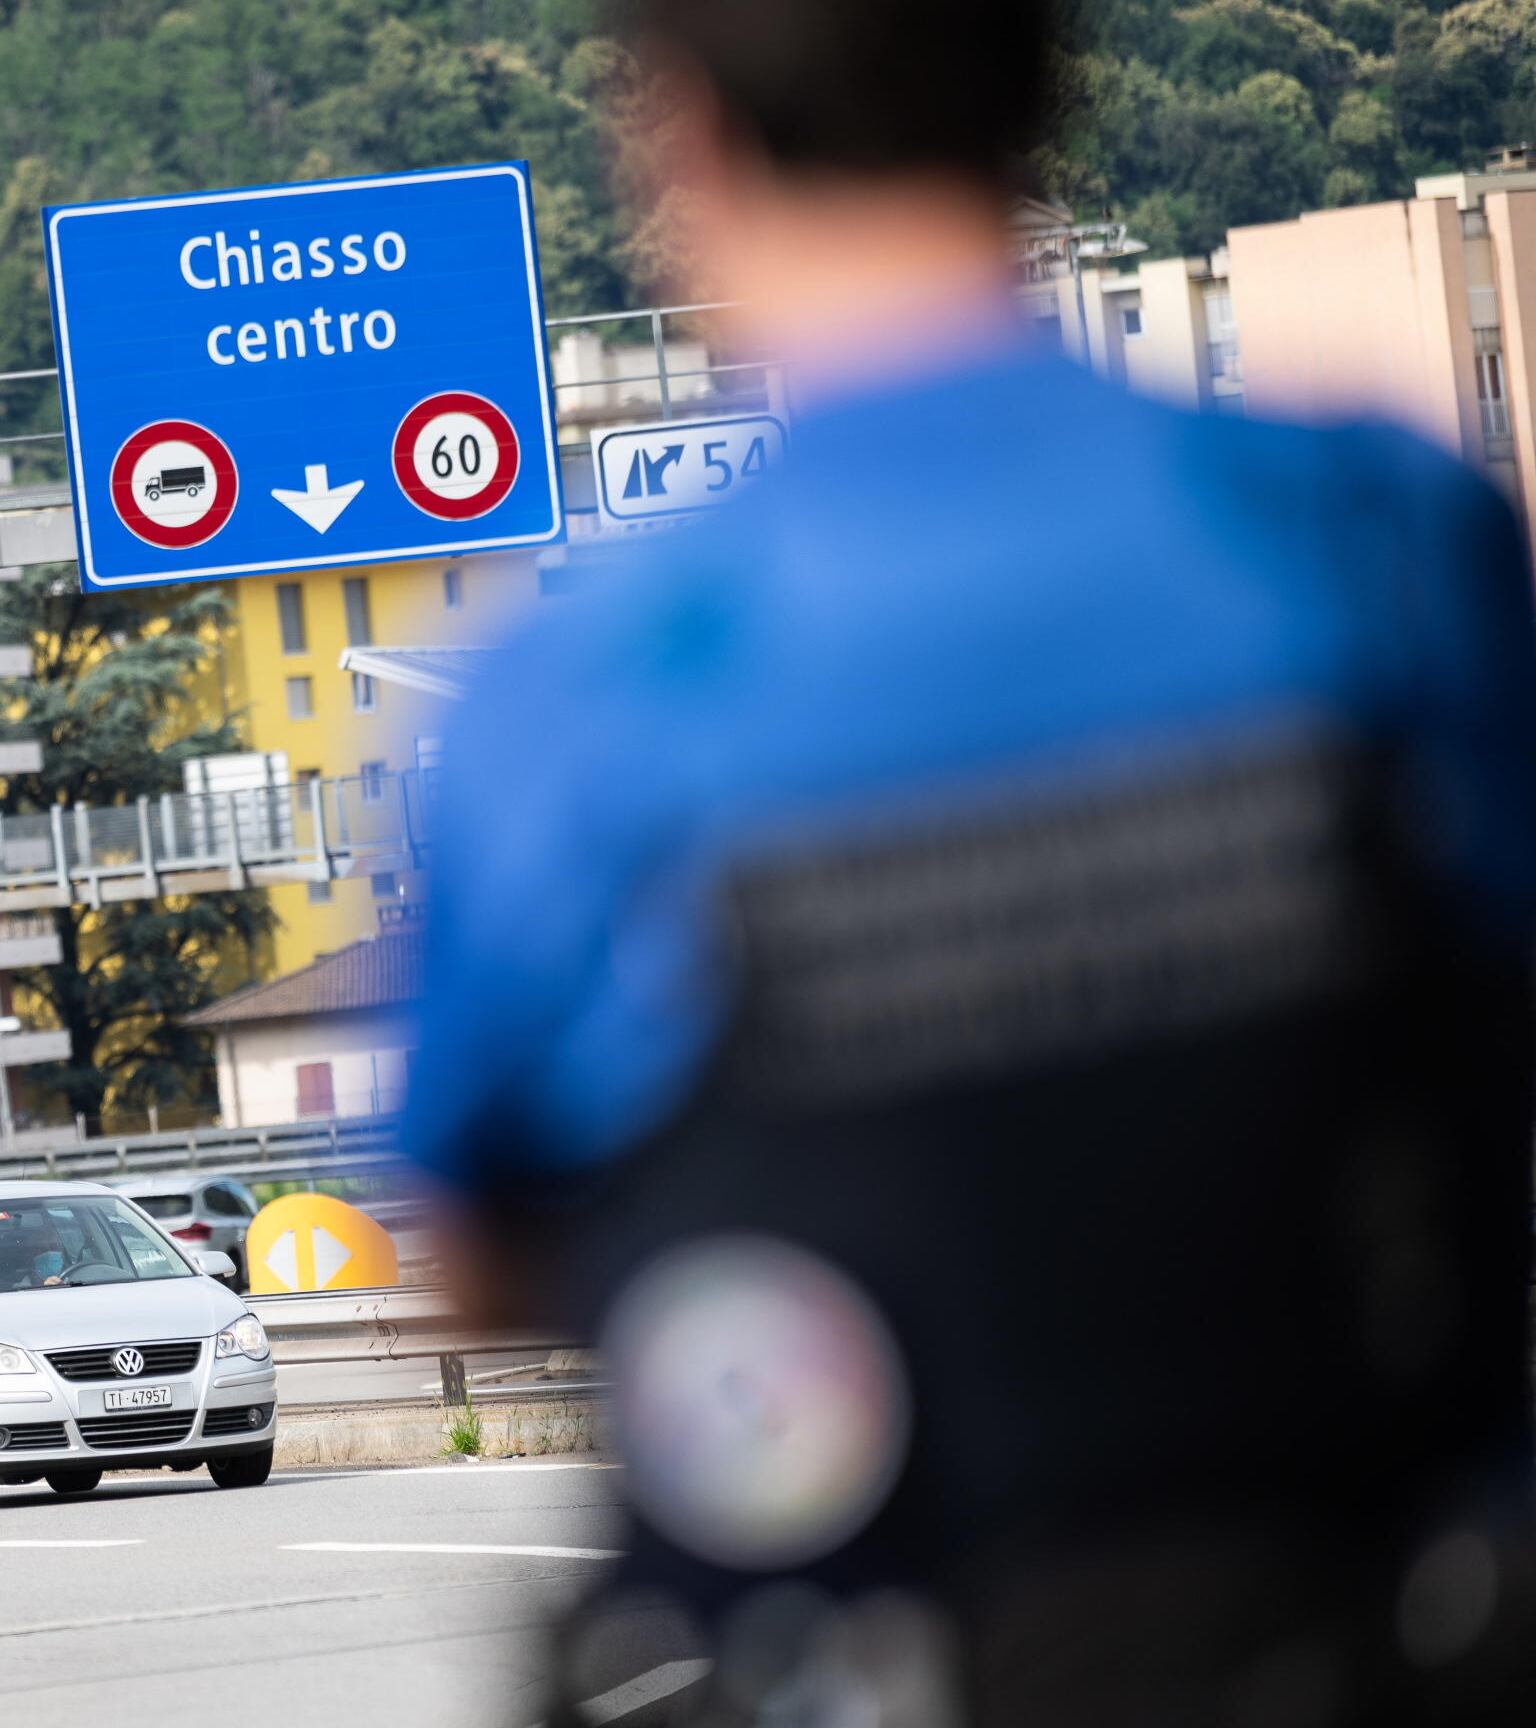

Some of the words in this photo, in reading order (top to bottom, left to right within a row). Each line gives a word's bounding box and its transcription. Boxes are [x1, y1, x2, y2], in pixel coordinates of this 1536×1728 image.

[179, 229, 407, 290] Chiasso
[207, 306, 397, 366] centro
[430, 433, 482, 480] 60
